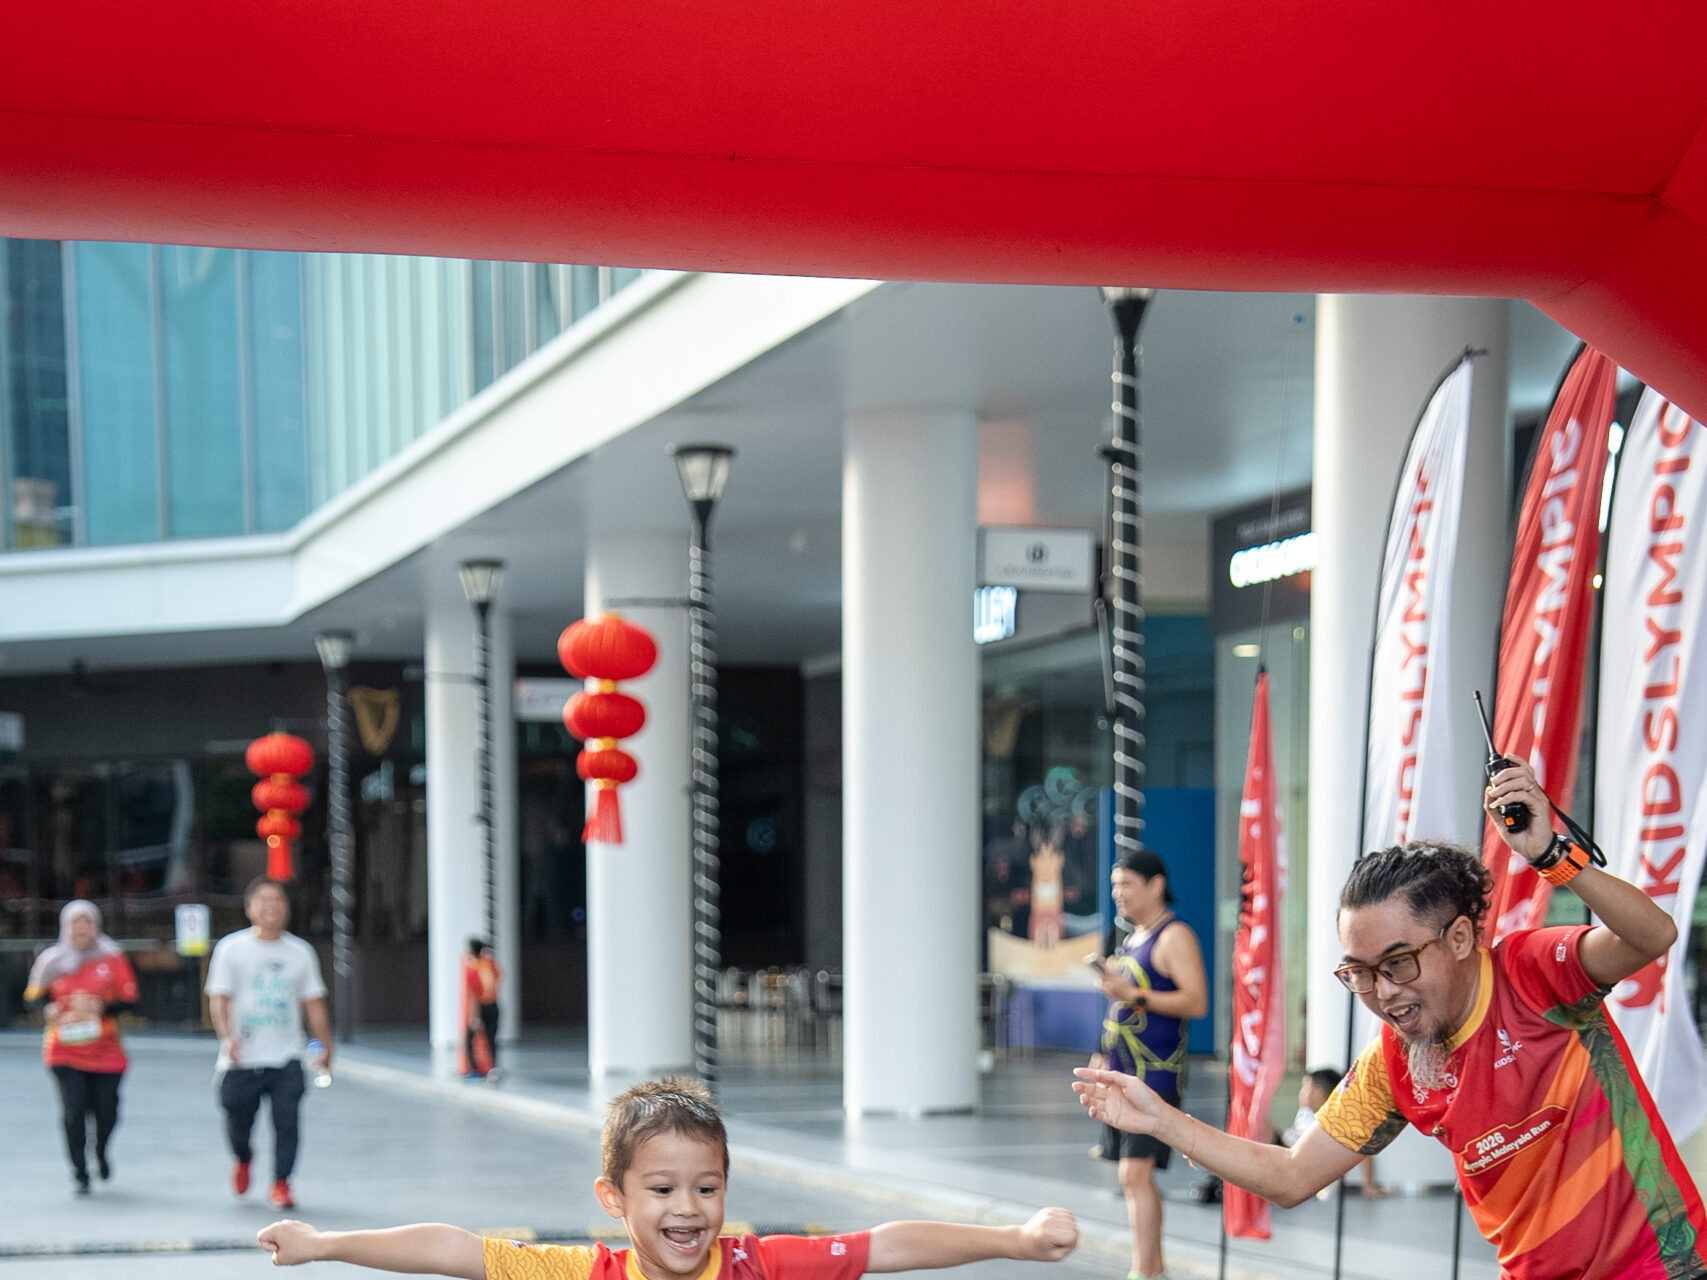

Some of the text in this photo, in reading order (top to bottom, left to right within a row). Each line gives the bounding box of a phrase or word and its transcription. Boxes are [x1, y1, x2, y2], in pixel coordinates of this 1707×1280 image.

[1639, 400, 1693, 898] KIDSLYMPIC
[1475, 1131, 1505, 1155] 2026
[1490, 1134, 1533, 1159] Malaysia
[1529, 1120, 1552, 1136] Run
